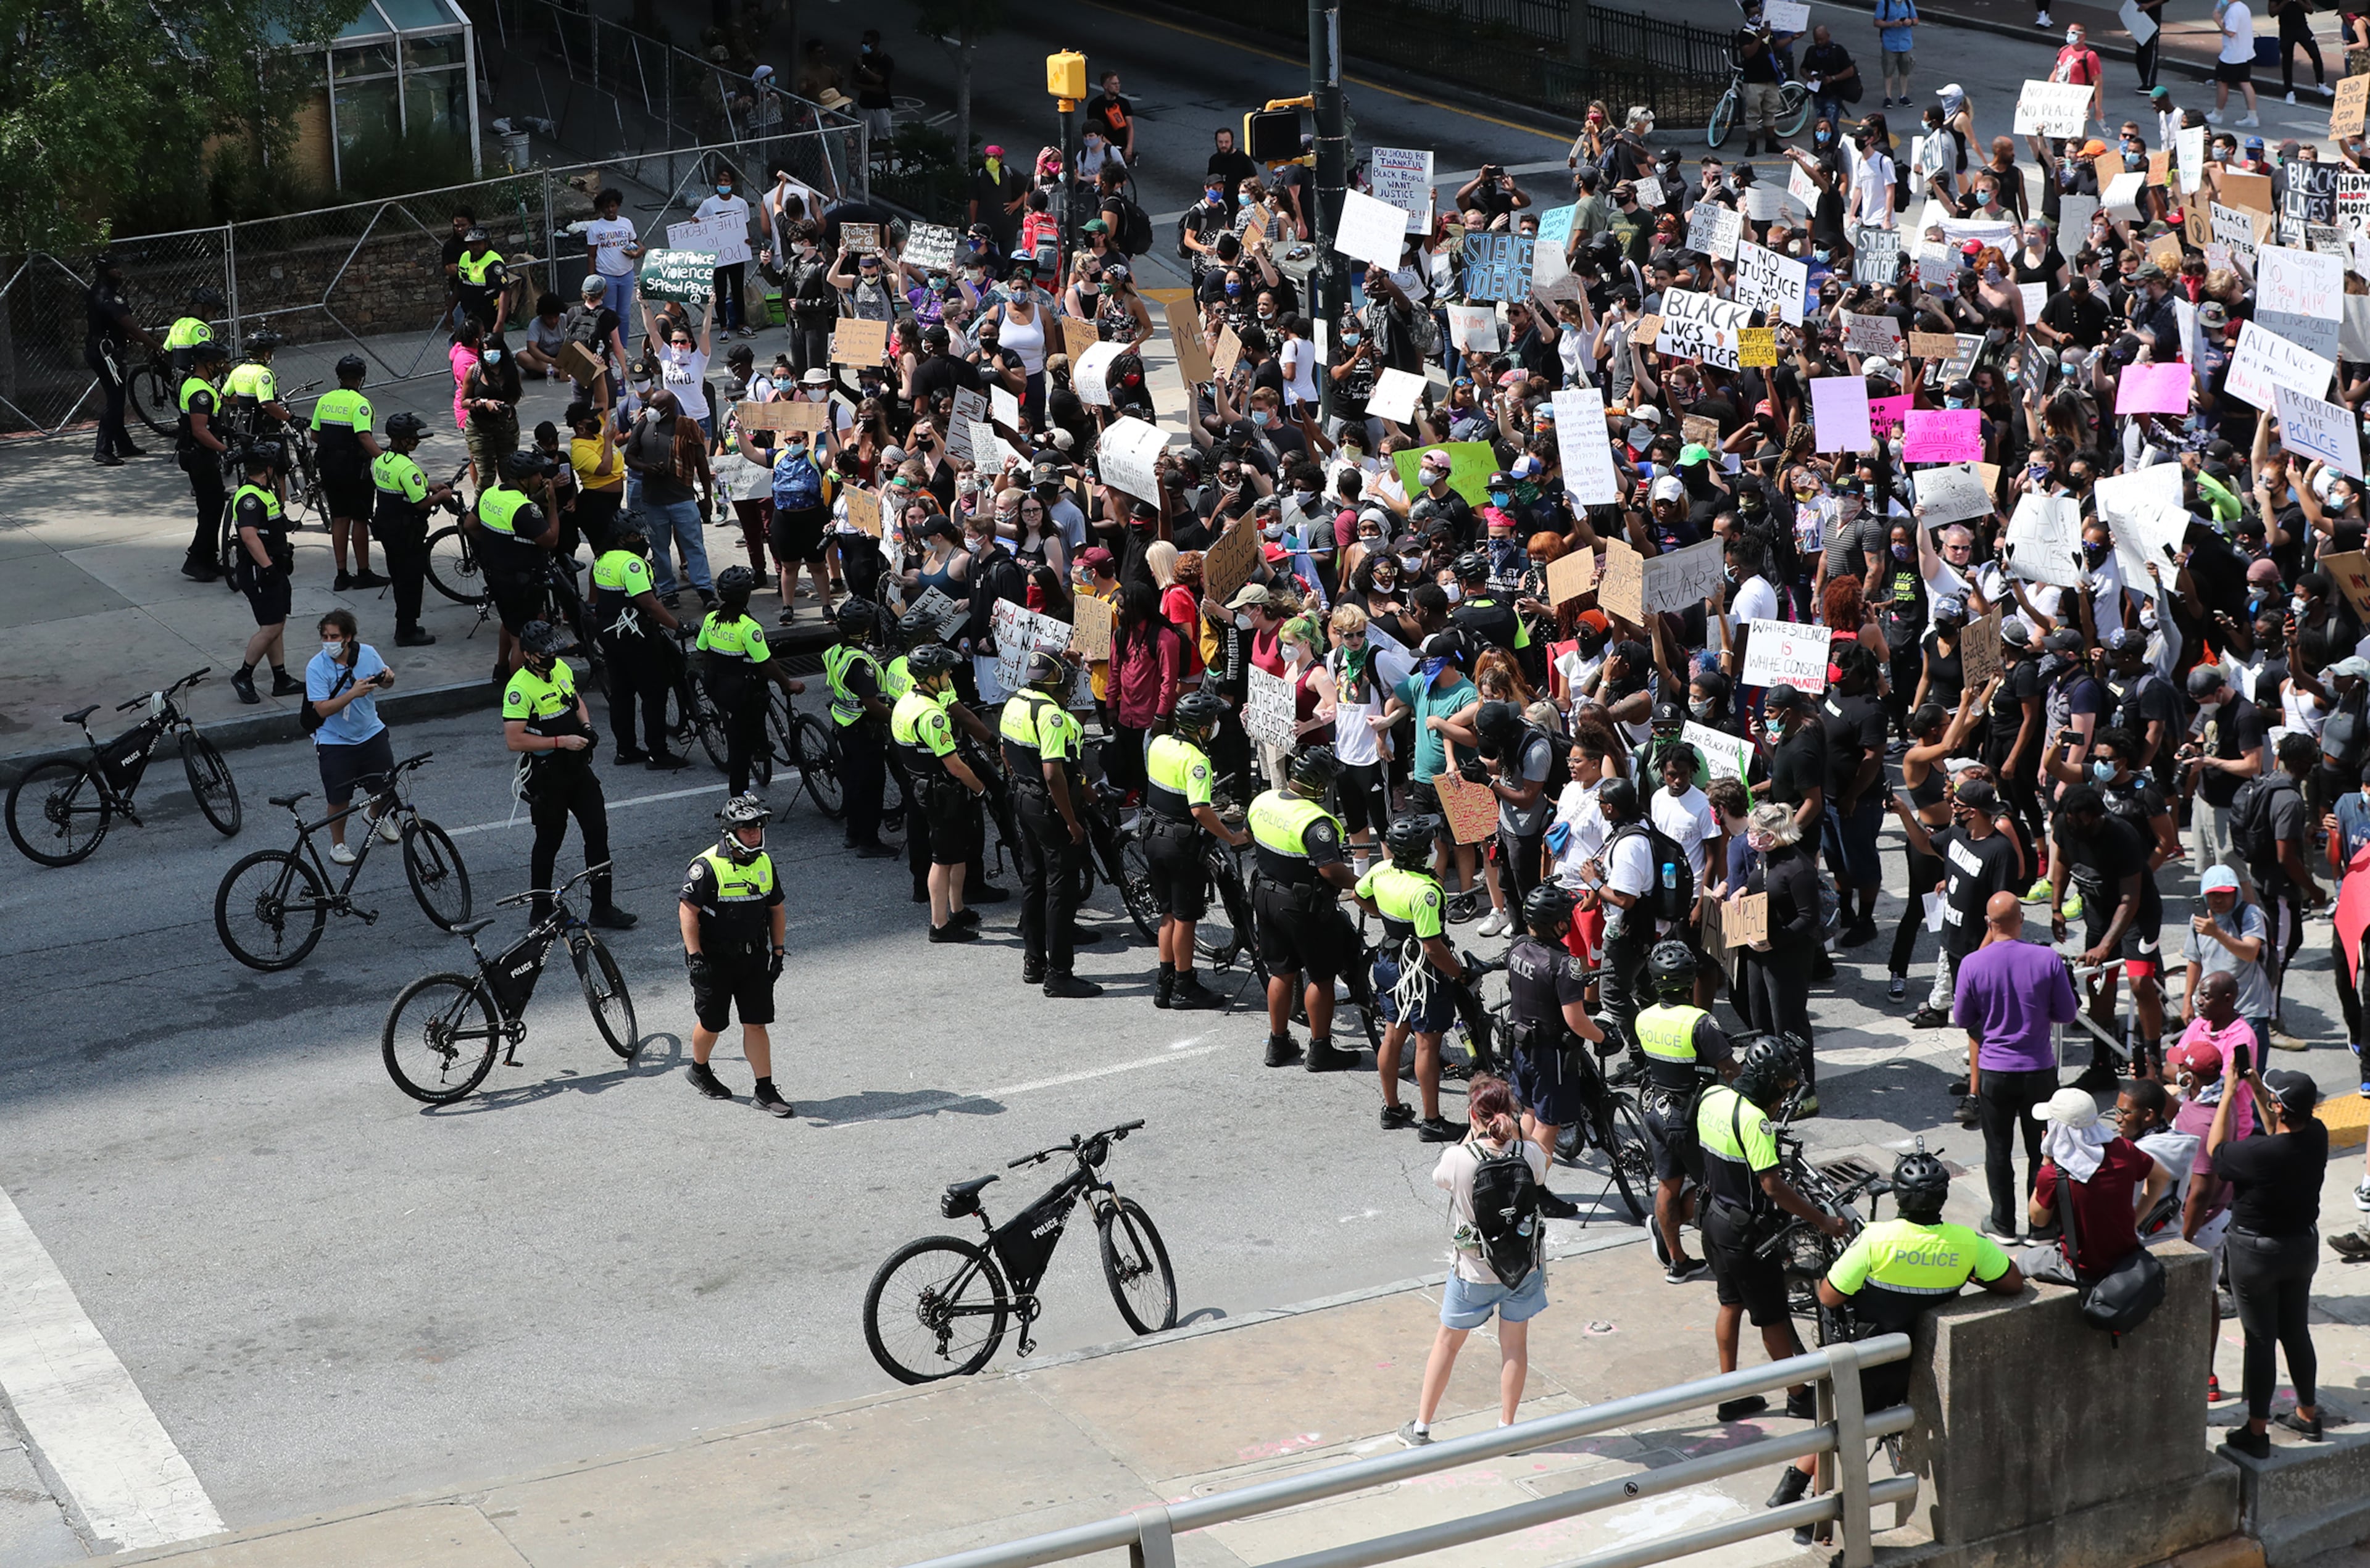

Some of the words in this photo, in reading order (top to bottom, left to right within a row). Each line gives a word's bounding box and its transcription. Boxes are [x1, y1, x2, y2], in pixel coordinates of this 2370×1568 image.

[2027, 88, 2042, 97] NO
[2342, 81, 2360, 95] END
[2021, 106, 2036, 117] NO
[2042, 104, 2077, 117] PEACE
[2337, 111, 2354, 120] COP
[2330, 122, 2363, 135] CULTURE
[1374, 149, 1387, 157] YOU
[1389, 150, 1413, 159] SHOULD
[1415, 152, 1426, 160] BE
[1379, 158, 1423, 168] THANKFUL
[1373, 167, 1397, 178] BLACK
[2287, 162, 2338, 194] BLACK
[1379, 189, 1415, 199] JUSTICE
[1387, 181, 1411, 189] WANT
[1790, 178, 1802, 195] NO
[1391, 199, 1408, 207] NOT
[2286, 191, 2329, 221] LIVES
[2339, 202, 2370, 214] MORE
[1695, 204, 1717, 217] BLACK
[1718, 208, 1738, 223] LIVES
[2214, 207, 2248, 229] BLACK
[842, 224, 875, 235] Protect
[1690, 225, 1703, 235] END
[1707, 229, 1733, 244] POLICE
[844, 235, 863, 246] Your
[1858, 230, 1900, 252] SILENCE
[2216, 233, 2258, 256] MATTER
[1463, 233, 1534, 270] SILENCE
[1758, 249, 1779, 273] NO
[660, 266, 713, 280] Violence
[1739, 259, 1799, 301] JUSTICE
[1462, 268, 1532, 304] VIOLENCE
[1762, 286, 1779, 300] NO
[1666, 289, 1747, 331] BLACK
[1739, 287, 1773, 314] PEAC
[1660, 321, 1703, 342] LIVES
[1846, 315, 1885, 331] BLACK
[1853, 338, 1895, 353] MATTER
[1858, 332, 1889, 342] LIVES
[1672, 339, 1739, 368] MATTER
[2244, 330, 2277, 360] ALL
[2286, 347, 2316, 376] lives
[1078, 376, 1101, 389] PIGS
[322, 404, 349, 415] POLICE
[2284, 388, 2351, 428] PROSECUTE
[2300, 412, 2325, 430] THE
[2288, 422, 2339, 455] POLICE
[376, 467, 391, 484] POLICE
[483, 499, 504, 516] POLICE
[1215, 524, 1241, 563] STOP
[1208, 538, 1254, 587] KILLING
[1658, 571, 1708, 607] WAR
[1075, 597, 1086, 610] NO
[992, 599, 1016, 624] Blood
[1017, 616, 1025, 628] in
[707, 626, 735, 642] POLICE
[1753, 621, 1787, 634] WHITE
[1788, 625, 1830, 644] SILENCE
[1226, 628, 1239, 680] CATERPILLAR
[1781, 641, 1792, 655] IS
[1748, 653, 1779, 672] WHITE
[1784, 659, 1827, 678] CONSENT
[888, 671, 907, 692] POLICE
[1250, 672, 1263, 687] HOW
[1263, 675, 1276, 694] ARE
[1277, 681, 1294, 701] YOU
[1249, 687, 1258, 705] ON
[1259, 691, 1271, 711] THE
[1272, 696, 1296, 721] WRONG
[1262, 712, 1270, 726] OF
[1683, 726, 1702, 744] DEAR
[1703, 734, 1726, 753] BLACK
[121, 750, 141, 766] POLICE
[359, 794, 381, 808] POLICE
[1259, 809, 1289, 832] POLICE
[1447, 796, 1472, 843] PROTECT
[1743, 897, 1766, 937] PEACE
[510, 960, 534, 978] POLICE
[1510, 953, 1536, 981] POLICE
[1640, 1028, 1682, 1048] POLICE
[1700, 1107, 1731, 1138] POLICE
[1031, 1217, 1060, 1238] POLICE
[1895, 1250, 1959, 1267] POLICE
